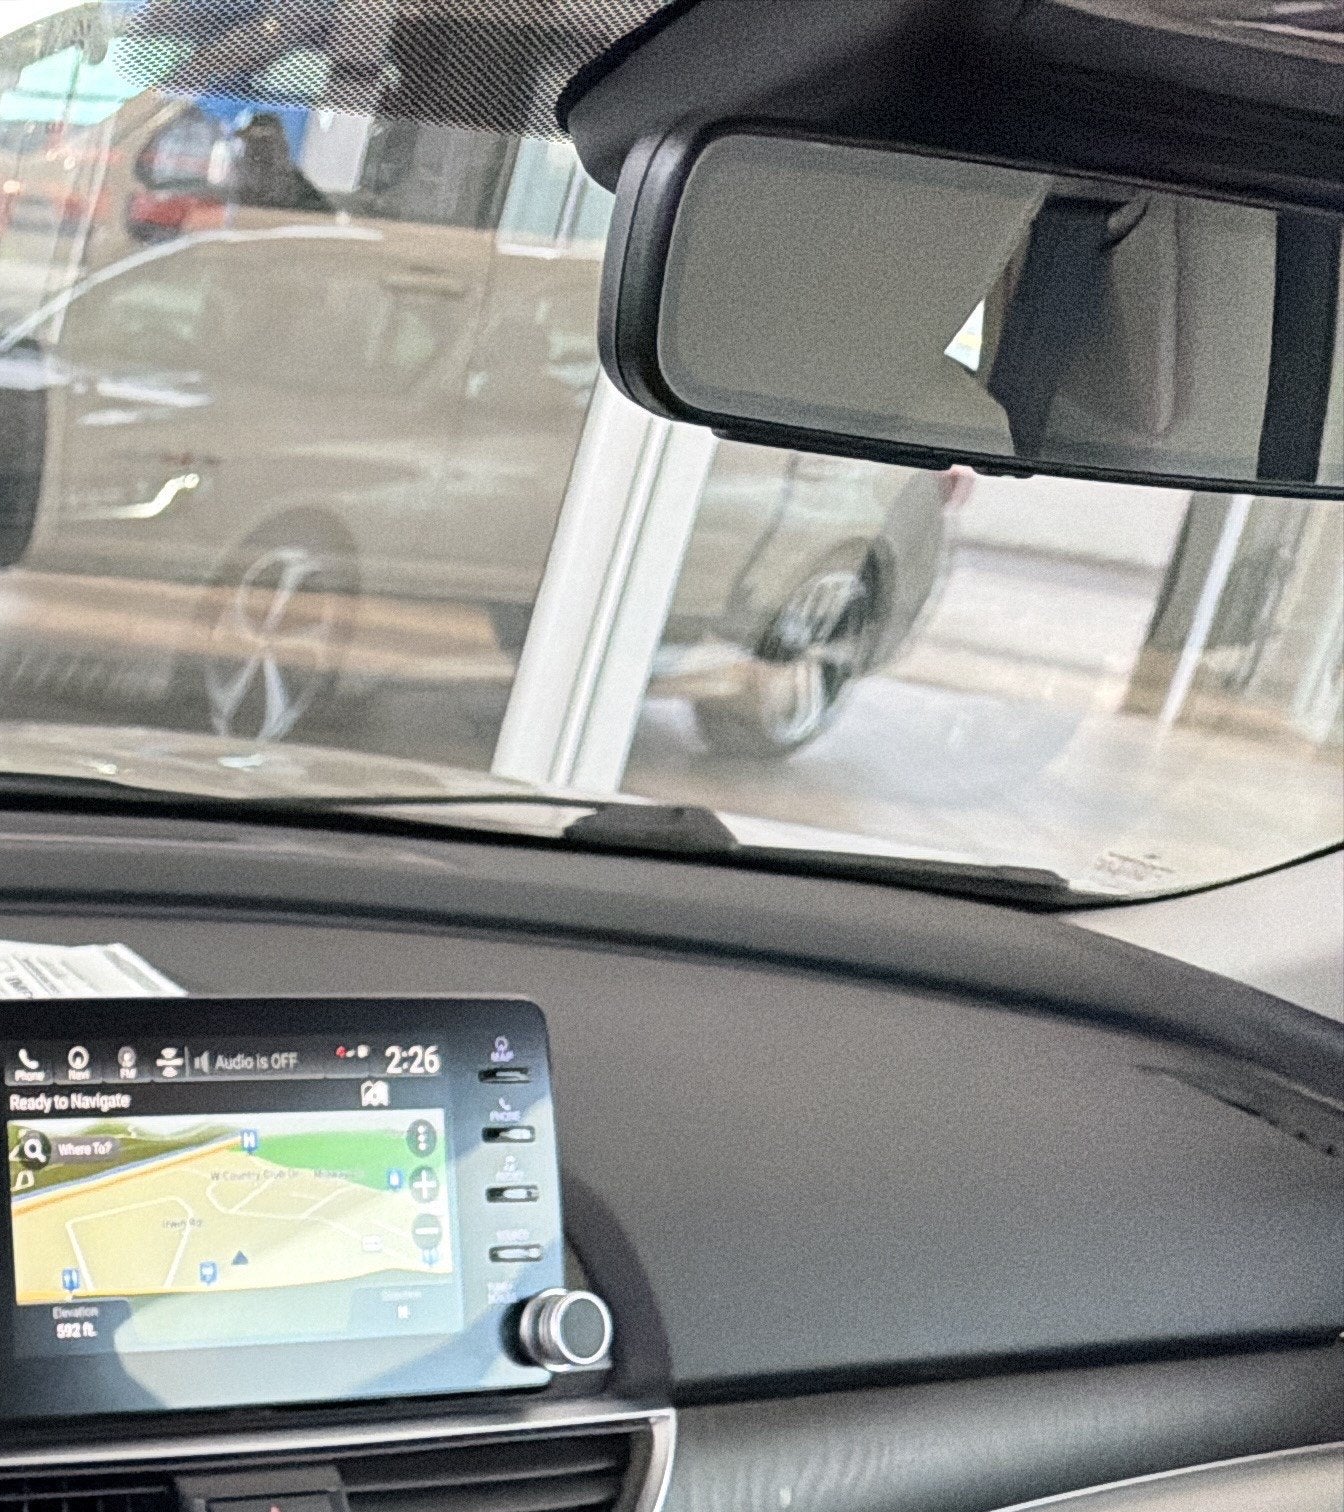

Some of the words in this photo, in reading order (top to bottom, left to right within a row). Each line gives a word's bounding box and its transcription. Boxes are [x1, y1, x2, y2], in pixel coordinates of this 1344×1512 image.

[215, 1055, 254, 1071] Audio
[256, 1056, 269, 1069] is
[270, 1053, 298, 1068] OFF
[385, 1045, 442, 1074] 2:26
[9, 1093, 52, 1114] Ready
[53, 1095, 69, 1110] to
[70, 1092, 132, 1112] Navigate
[57, 1143, 92, 1157] Where
[92, 1142, 113, 1156] To?
[52, 1306, 99, 1319] Elevation
